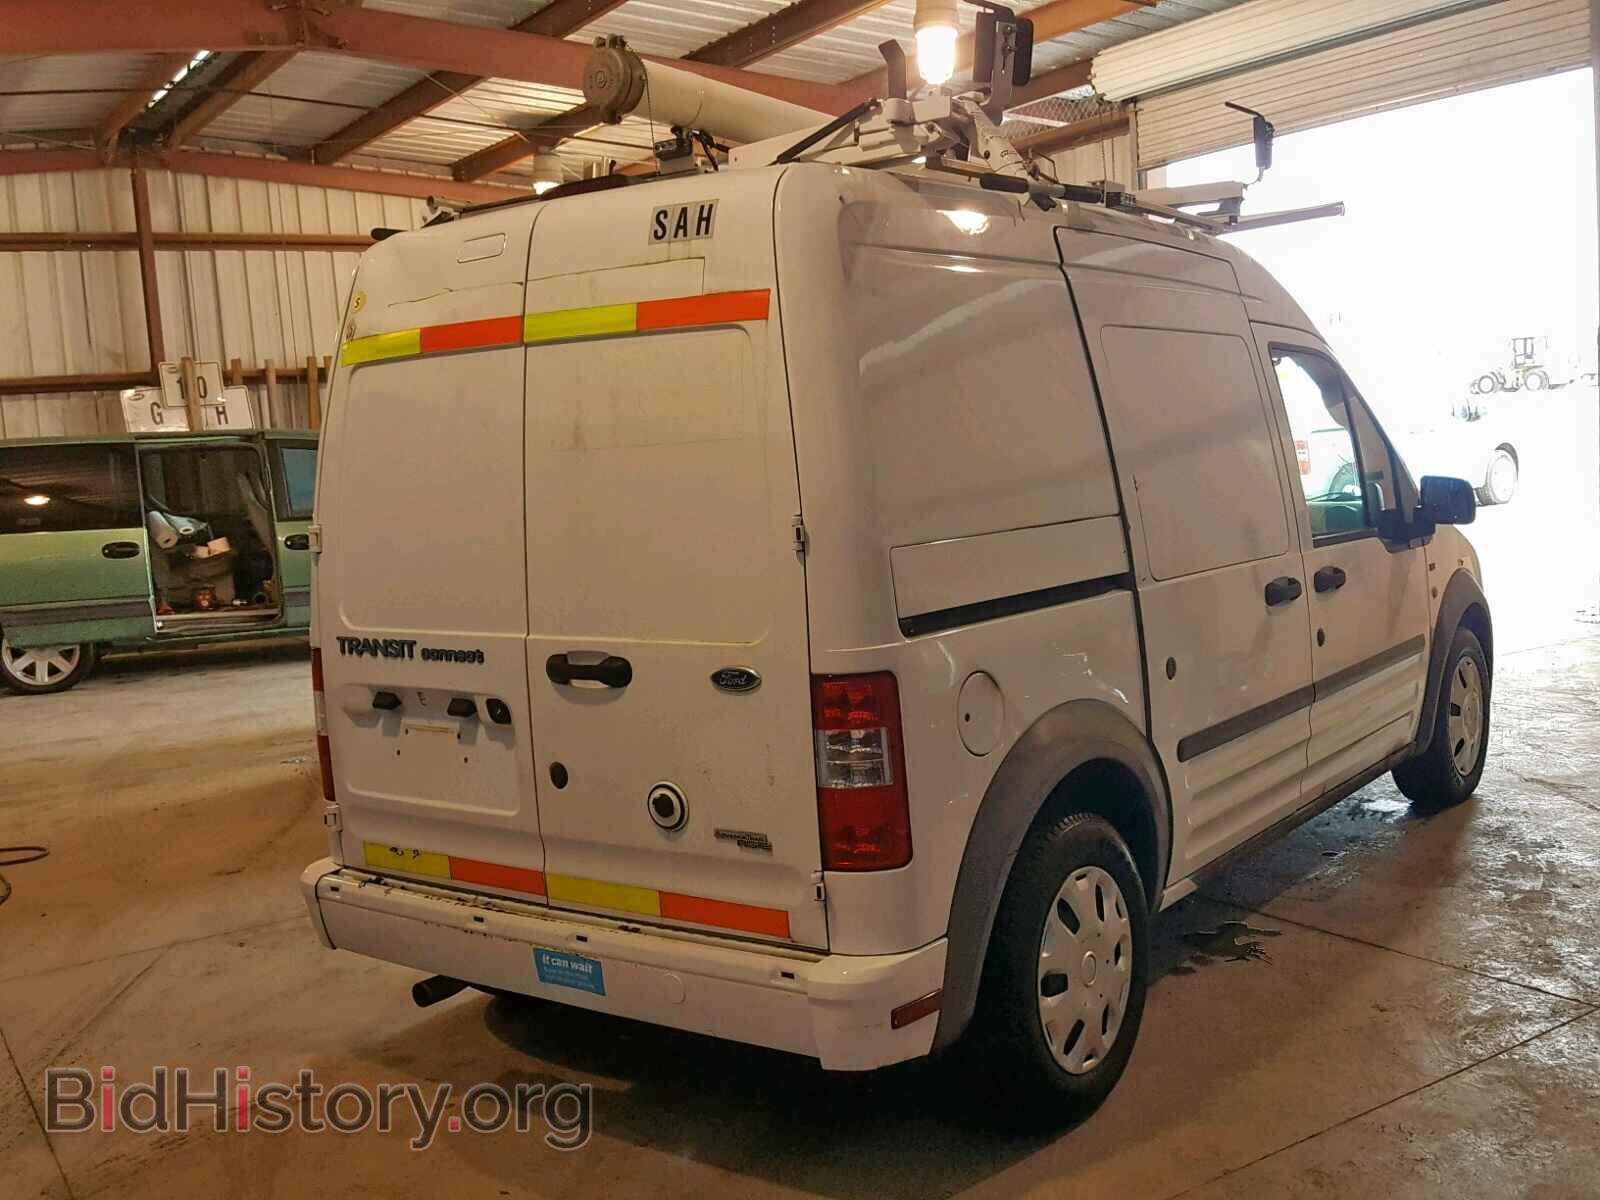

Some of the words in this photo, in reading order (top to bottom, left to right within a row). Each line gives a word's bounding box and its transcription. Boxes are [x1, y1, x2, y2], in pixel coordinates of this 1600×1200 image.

[653, 203, 714, 241] SAH
[150, 402, 164, 425] G
[215, 404, 229, 425] H
[336, 636, 417, 660] TRANSIT
[421, 647, 485, 665] connect
